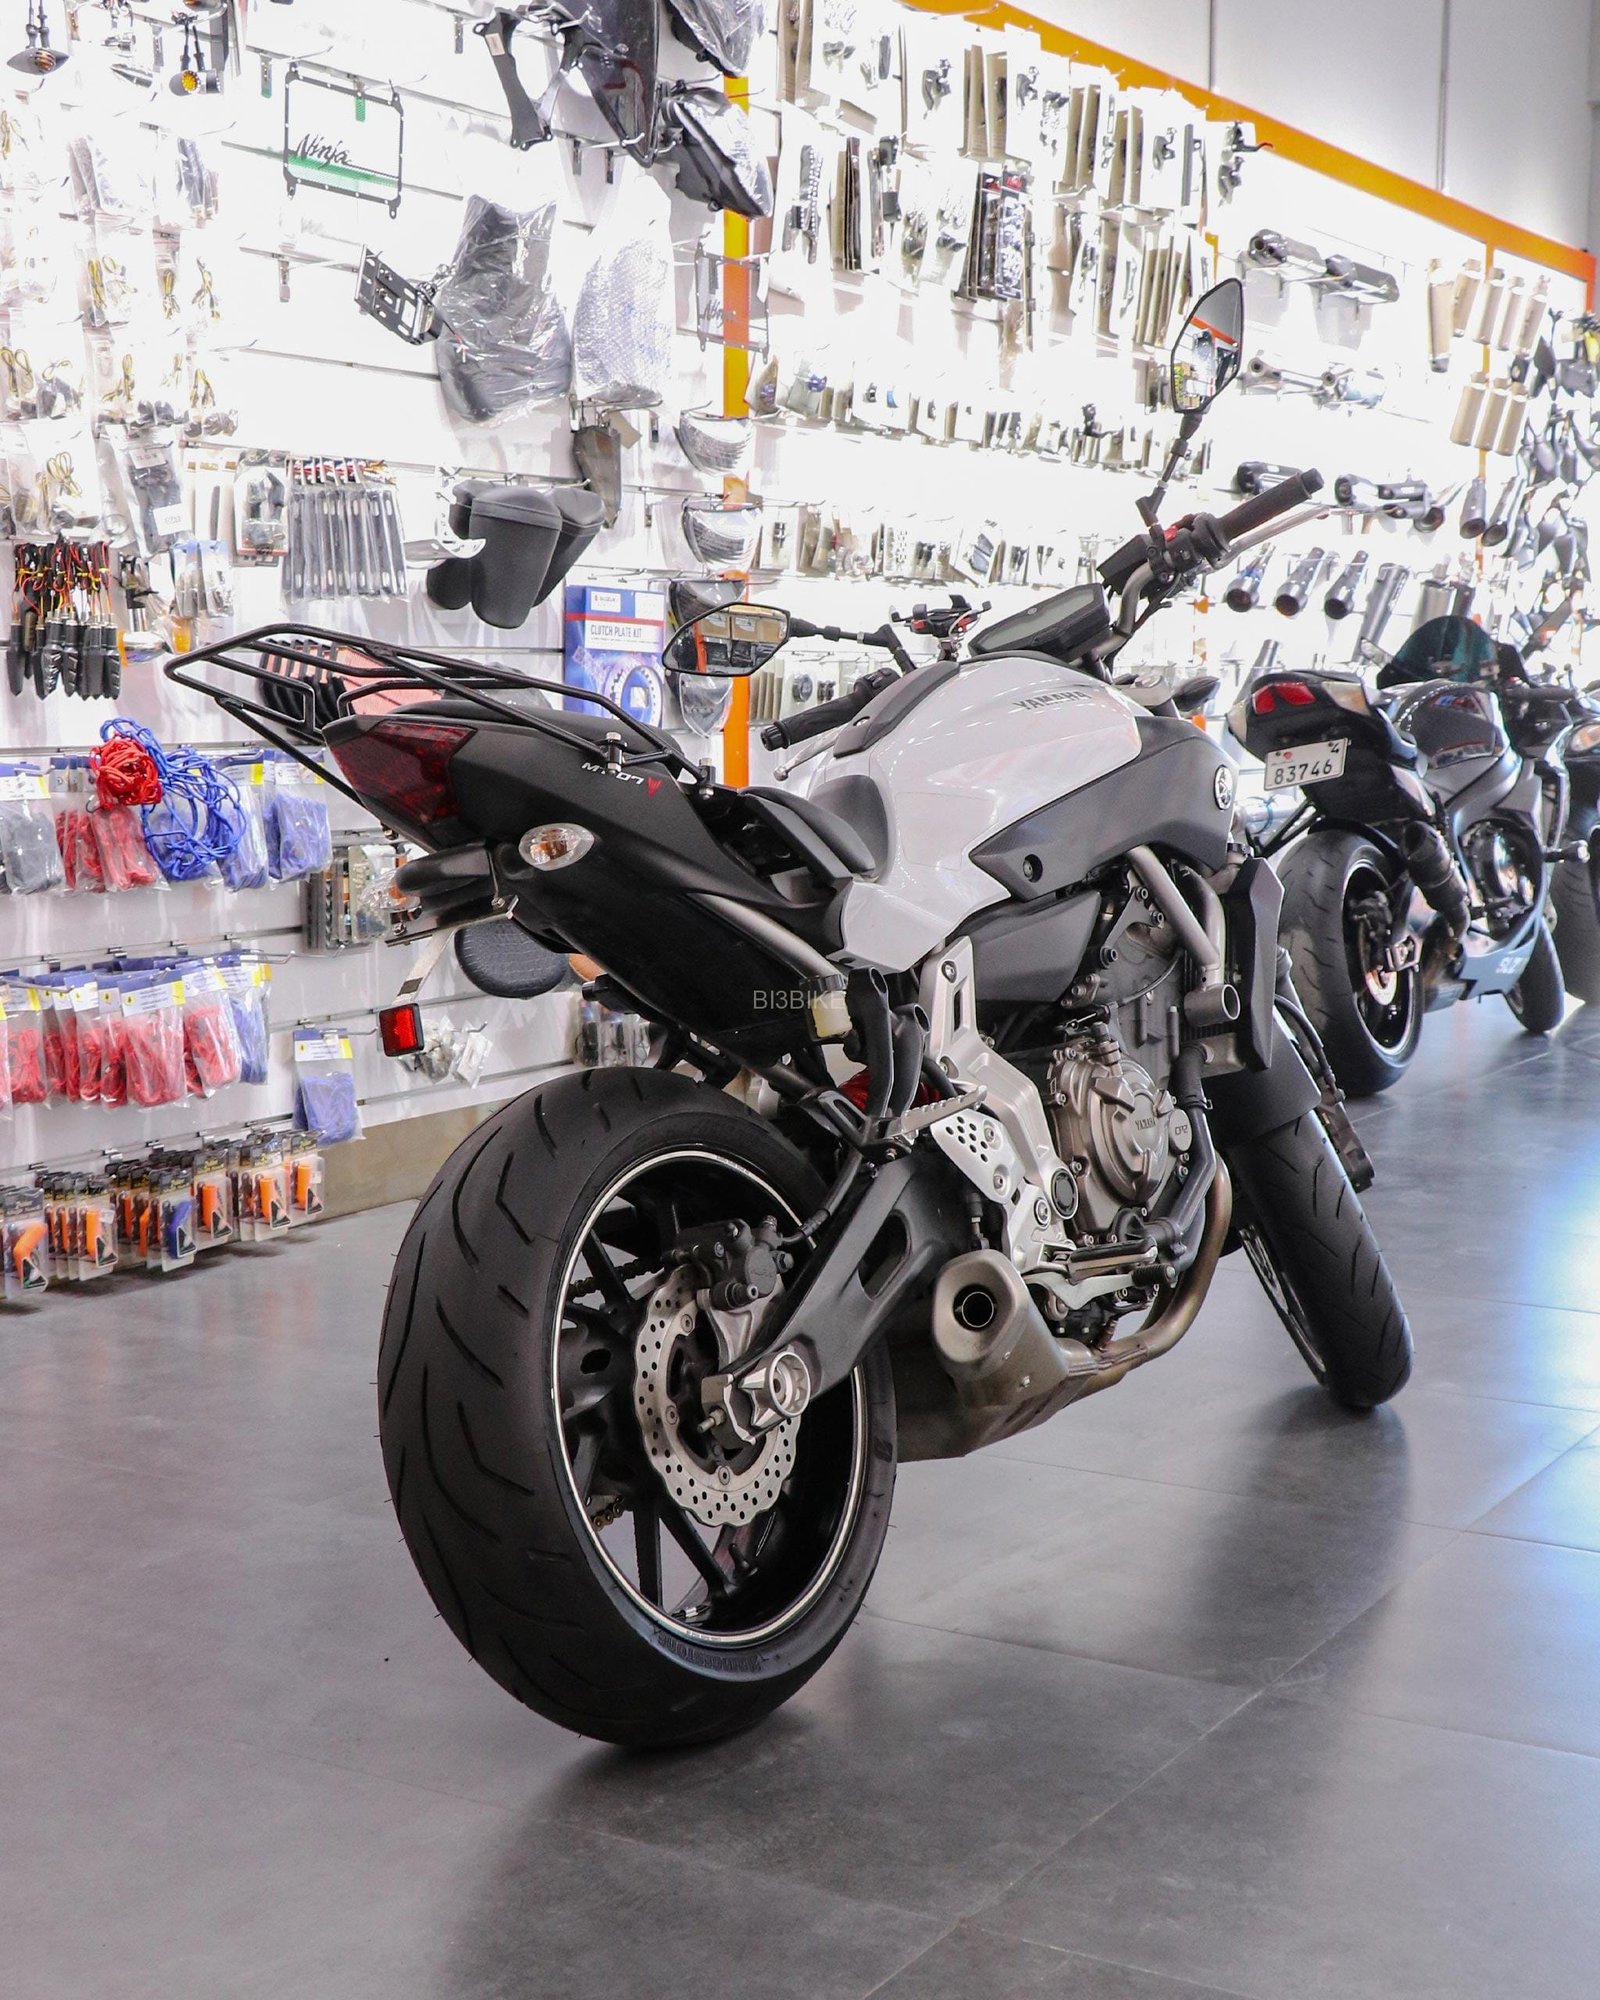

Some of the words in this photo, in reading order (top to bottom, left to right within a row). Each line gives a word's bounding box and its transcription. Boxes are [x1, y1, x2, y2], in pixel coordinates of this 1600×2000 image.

[296, 133, 353, 169] Ninja
[591, 624, 613, 636] CLUTCH
[614, 626, 631, 638] PLATE
[633, 628, 642, 638] KIT
[1012, 691, 1092, 710] YAMAHA
[1331, 742, 1340, 754] 4
[581, 762, 645, 785] M07
[1274, 759, 1333, 785] 83746
